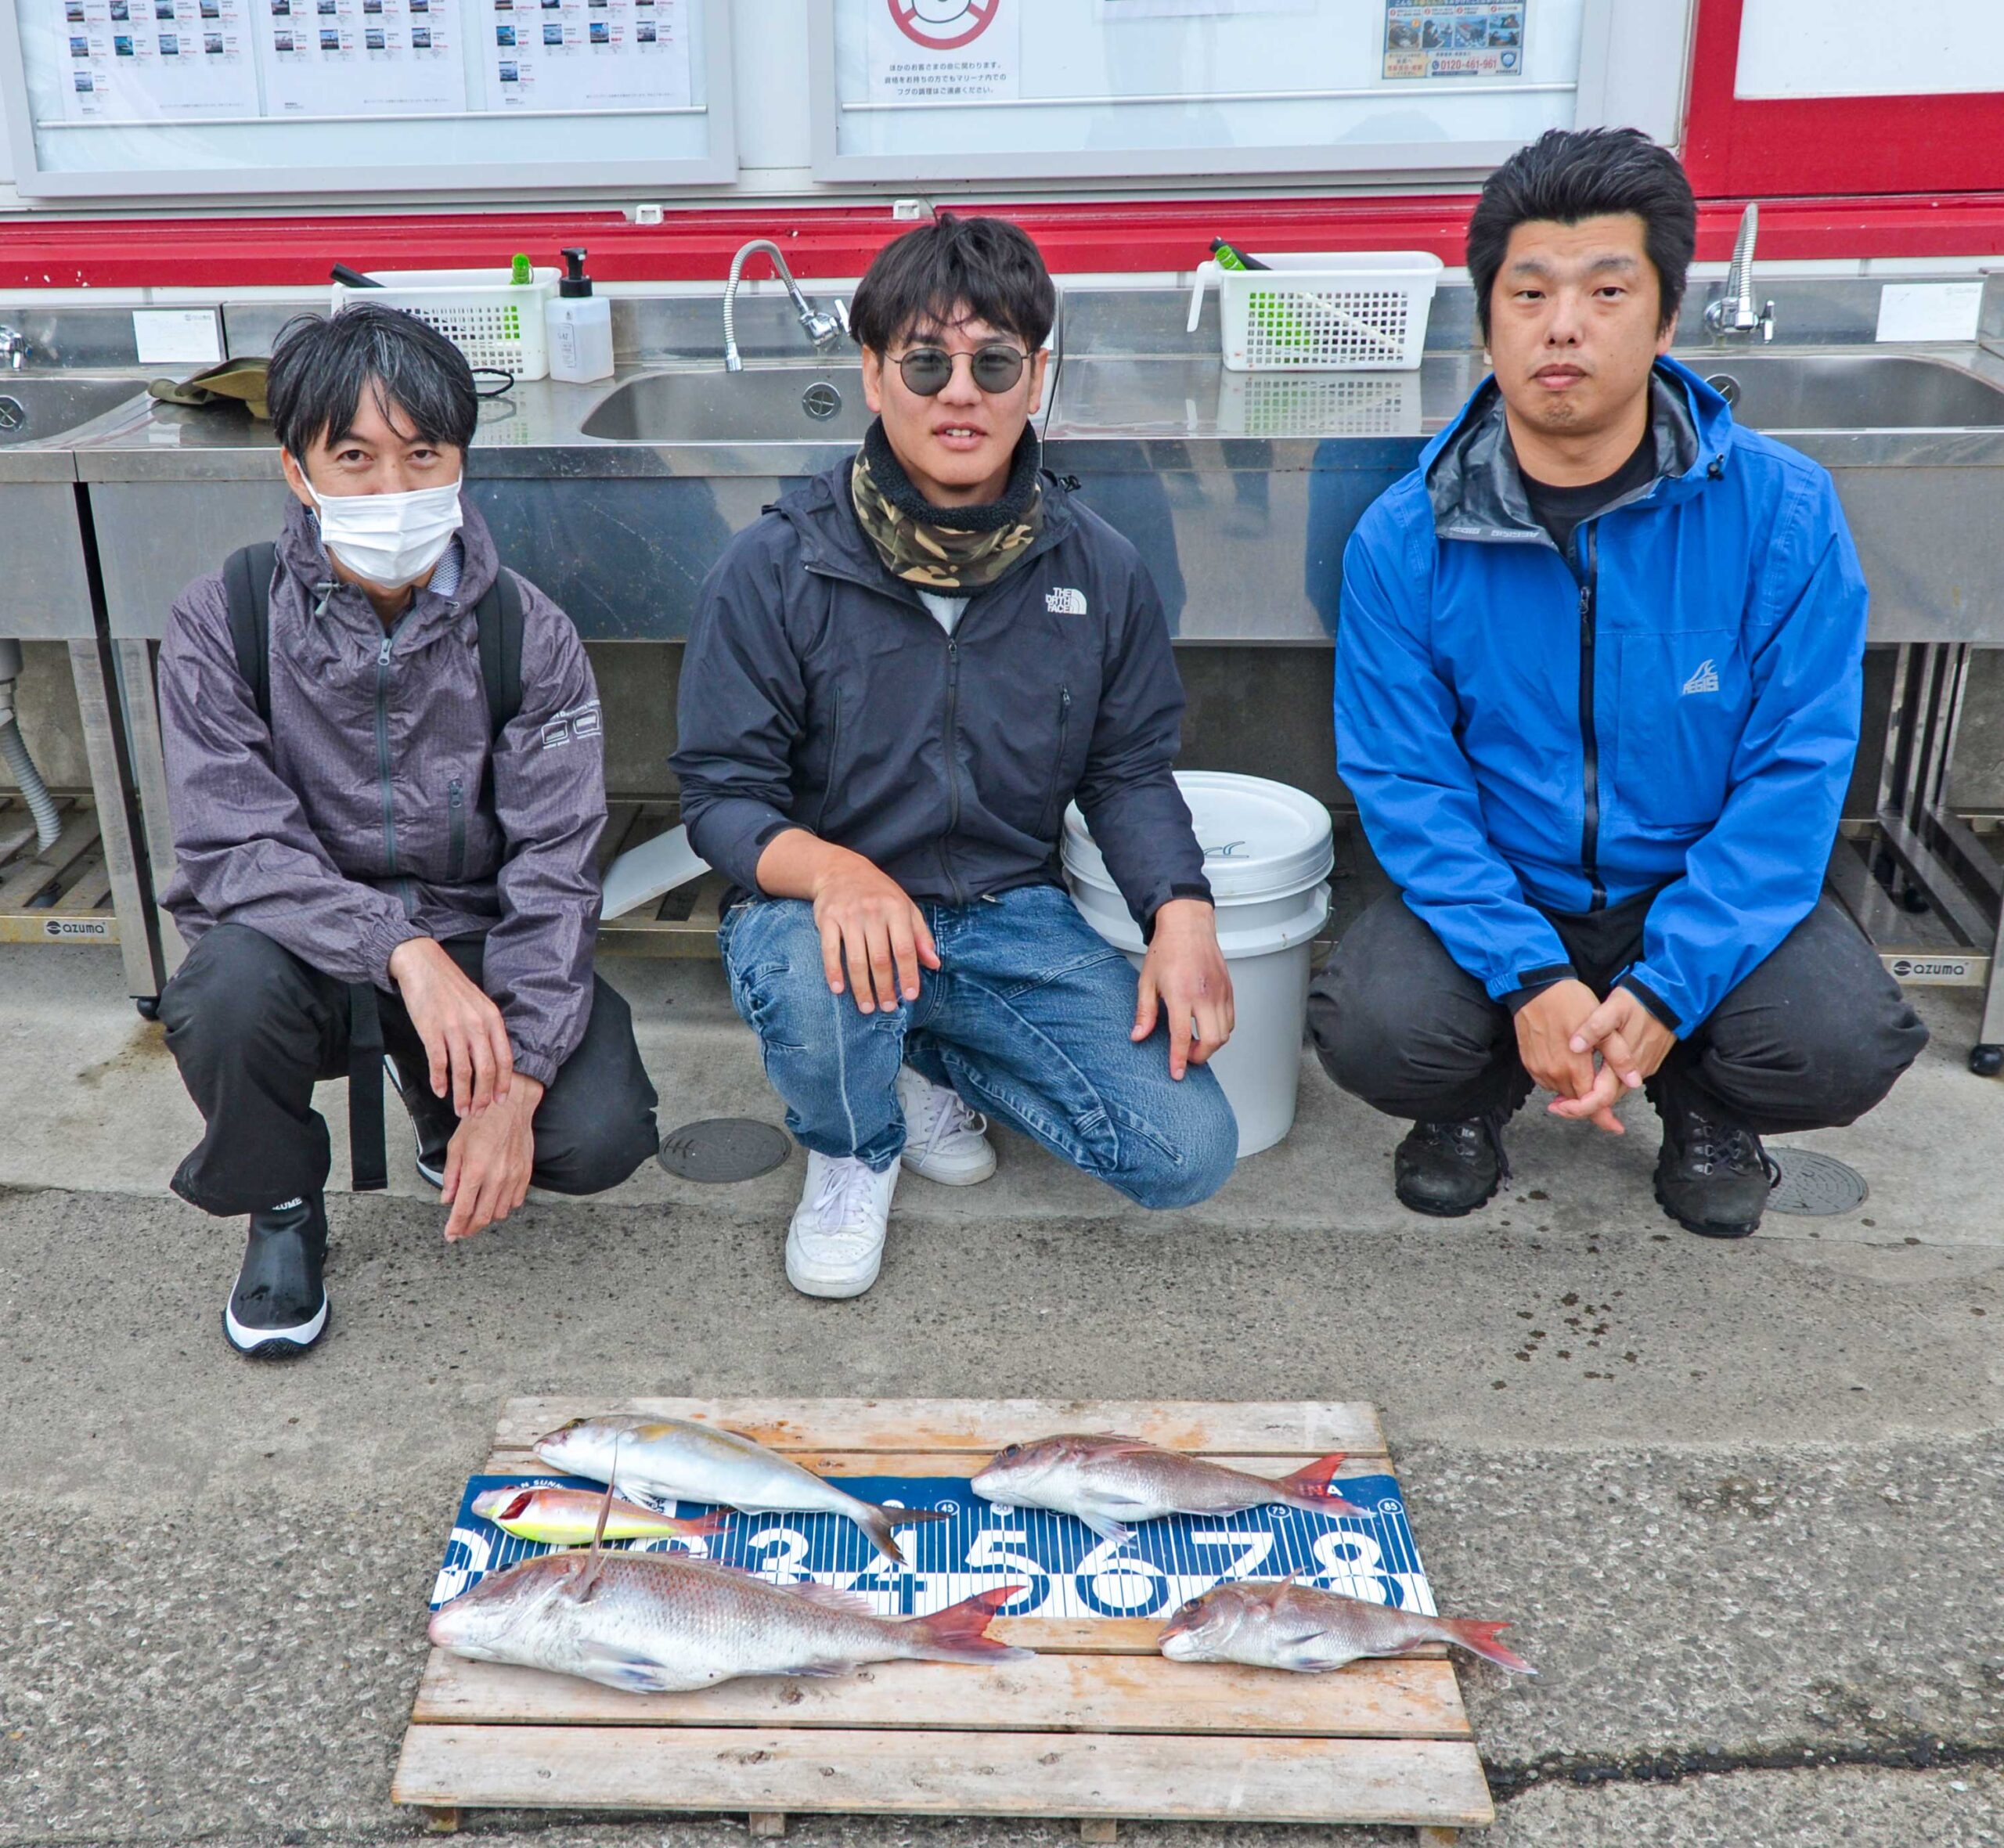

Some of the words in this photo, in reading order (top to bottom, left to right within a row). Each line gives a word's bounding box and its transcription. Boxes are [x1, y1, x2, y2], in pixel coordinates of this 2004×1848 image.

[1053, 587, 1072, 596] THE
[1047, 604, 1070, 614] FACE
[63, 924, 104, 934] azuma
[1913, 964, 1964, 975] azuma
[1271, 1505, 1286, 1515] 75
[748, 1527, 816, 1585] 3
[846, 1530, 927, 1616] 4
[964, 1530, 1050, 1616] 5
[1076, 1531, 1170, 1617] 6
[1191, 1532, 1274, 1587] 7
[1311, 1531, 1404, 1608] 8
